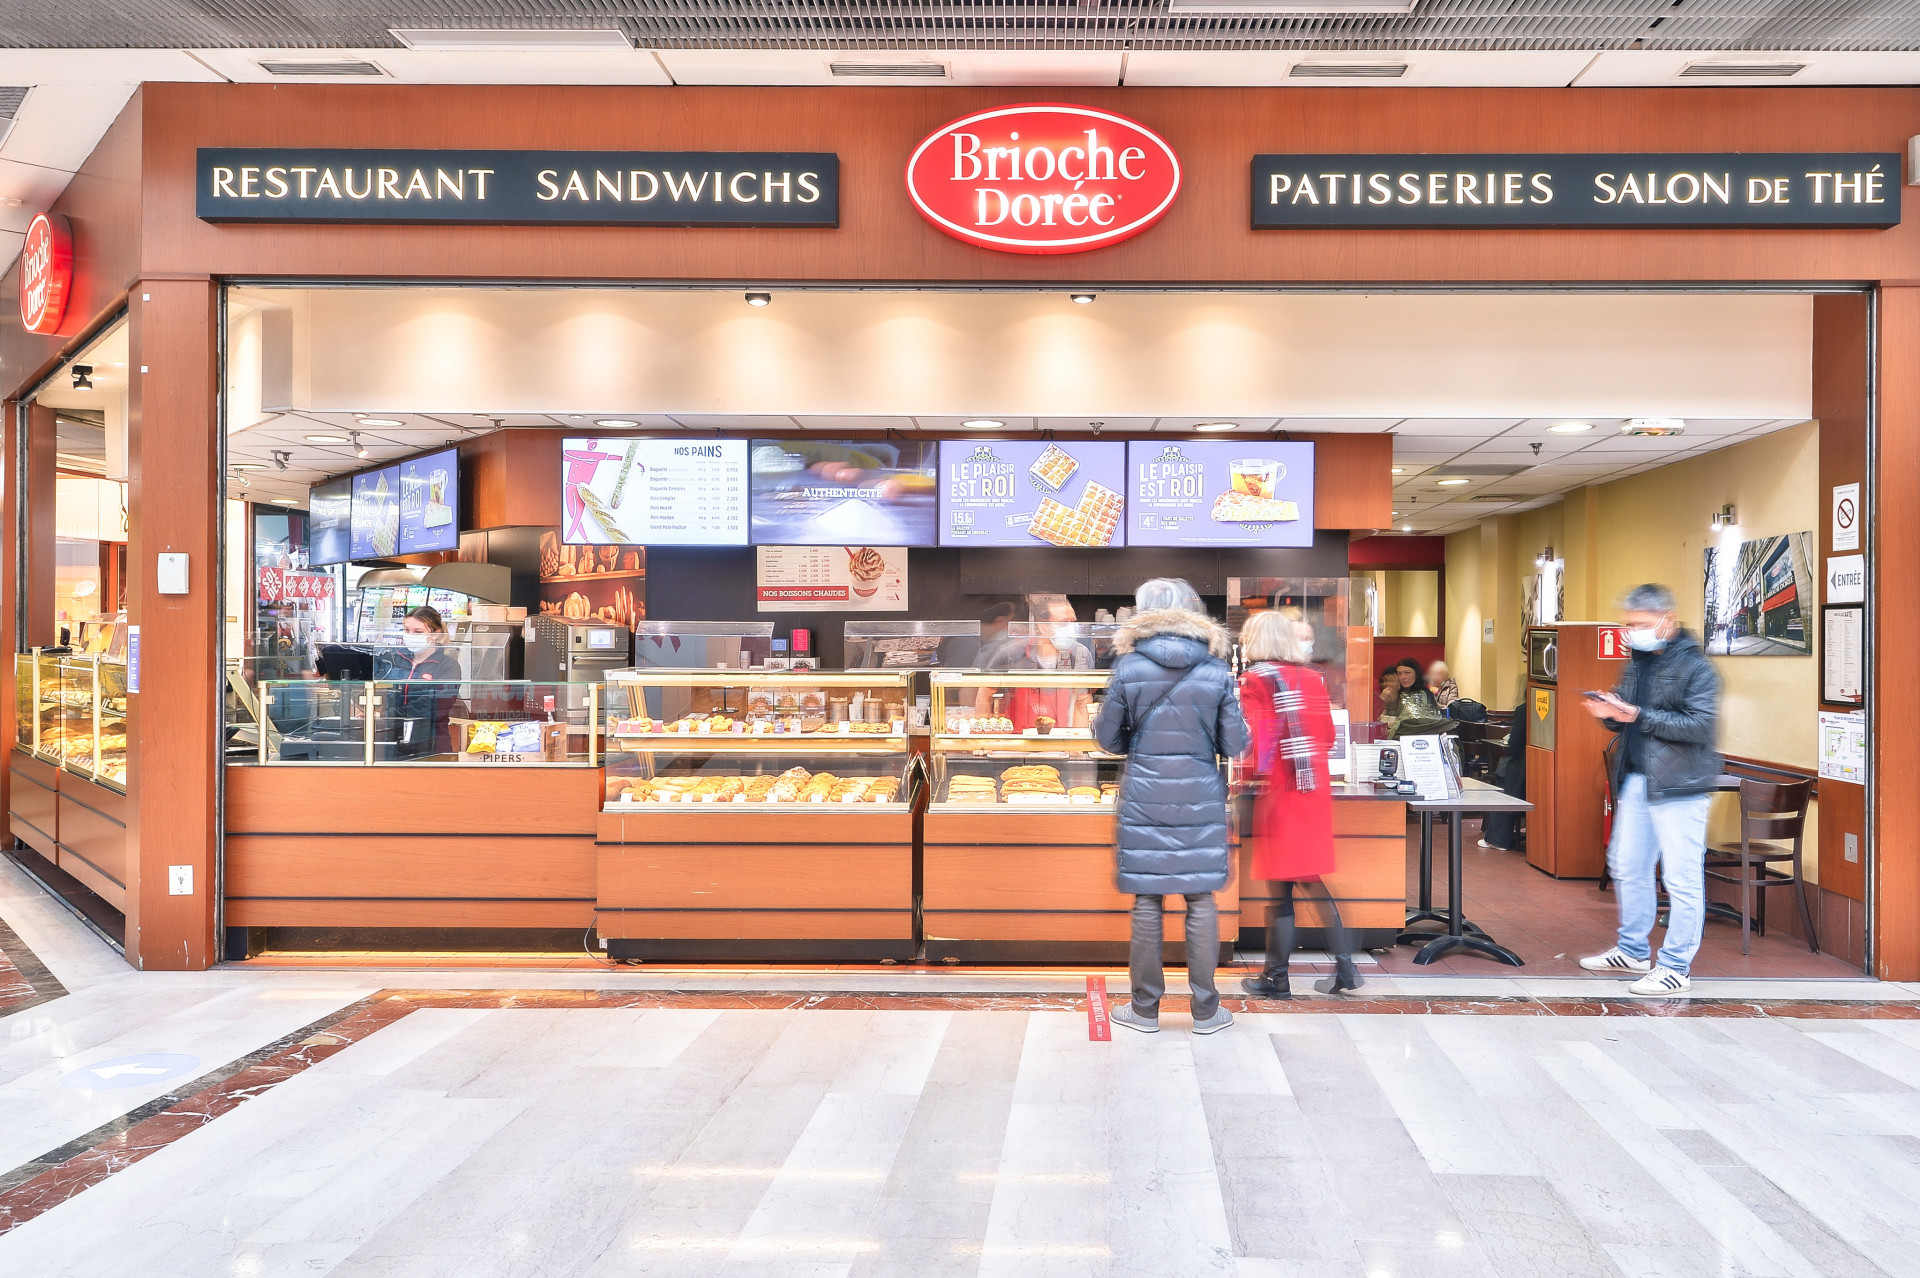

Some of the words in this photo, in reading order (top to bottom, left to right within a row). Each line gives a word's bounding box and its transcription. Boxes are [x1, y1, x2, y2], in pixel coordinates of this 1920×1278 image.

[950, 128, 1146, 181] Brioche
[212, 166, 495, 200] RESTAURANT
[536, 169, 820, 203] SANDWICHS
[1270, 173, 1554, 204] PATISSERIES
[1593, 172, 1730, 204] SALON
[1748, 178, 1790, 204] DE
[1805, 163, 1885, 204] THÉ
[974, 181, 1116, 226] Dorée
[24, 228, 49, 290] Brioche
[674, 446, 690, 456] NOS
[691, 445, 722, 458] PAINS
[951, 463, 969, 482] LE
[973, 463, 1015, 479] PLAISIR
[1139, 463, 1158, 482] LE
[1162, 463, 1204, 479] PLAISIR
[802, 486, 883, 498] AUTHENTICITÉ
[951, 480, 977, 497] EST
[981, 473, 1015, 497] ROI
[1139, 479, 1165, 497] EST
[1170, 473, 1204, 497] ROI
[1837, 570, 1861, 587] ENTRÉE
[813, 590, 846, 598] CHAUDES
[483, 754, 522, 763] PIPERS
